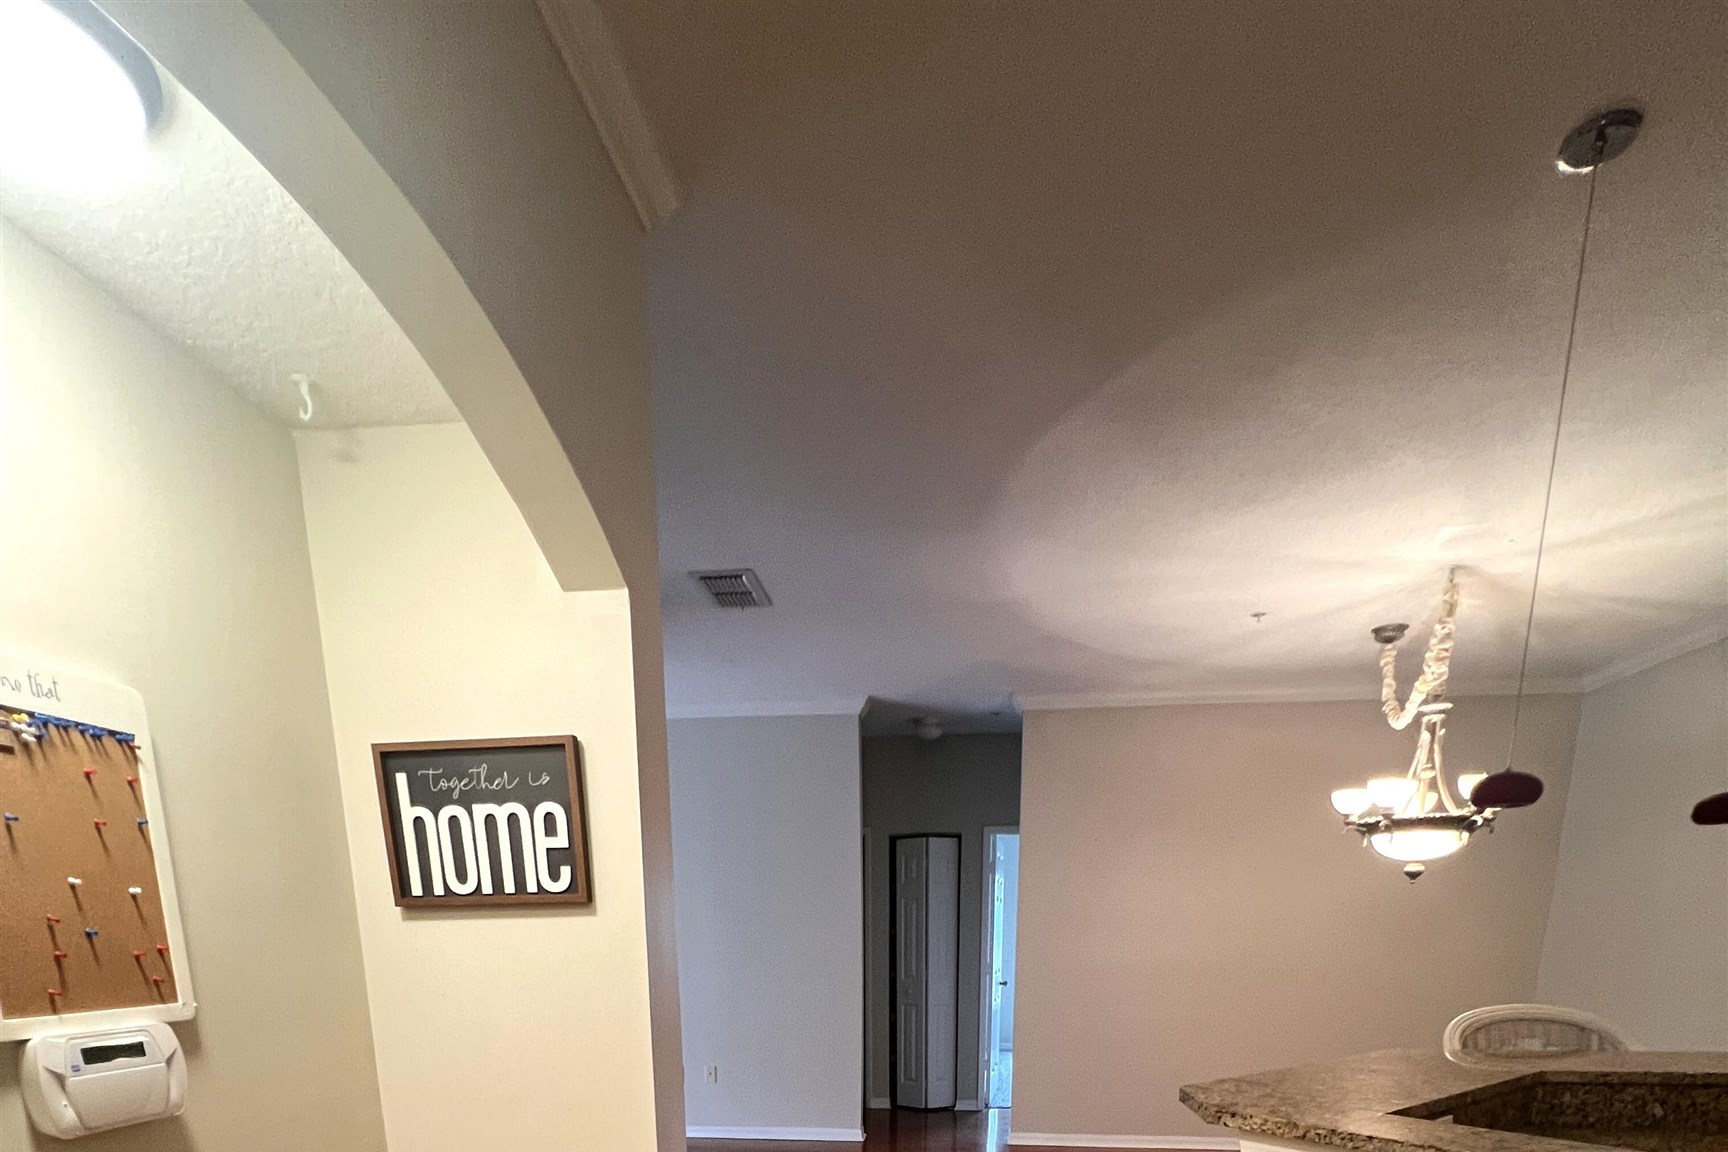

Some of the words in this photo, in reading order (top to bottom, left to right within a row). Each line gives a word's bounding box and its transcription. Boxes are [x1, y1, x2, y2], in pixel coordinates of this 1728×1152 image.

[27, 669, 61, 702] that
[528, 770, 550, 786] is
[395, 772, 572, 897] home
